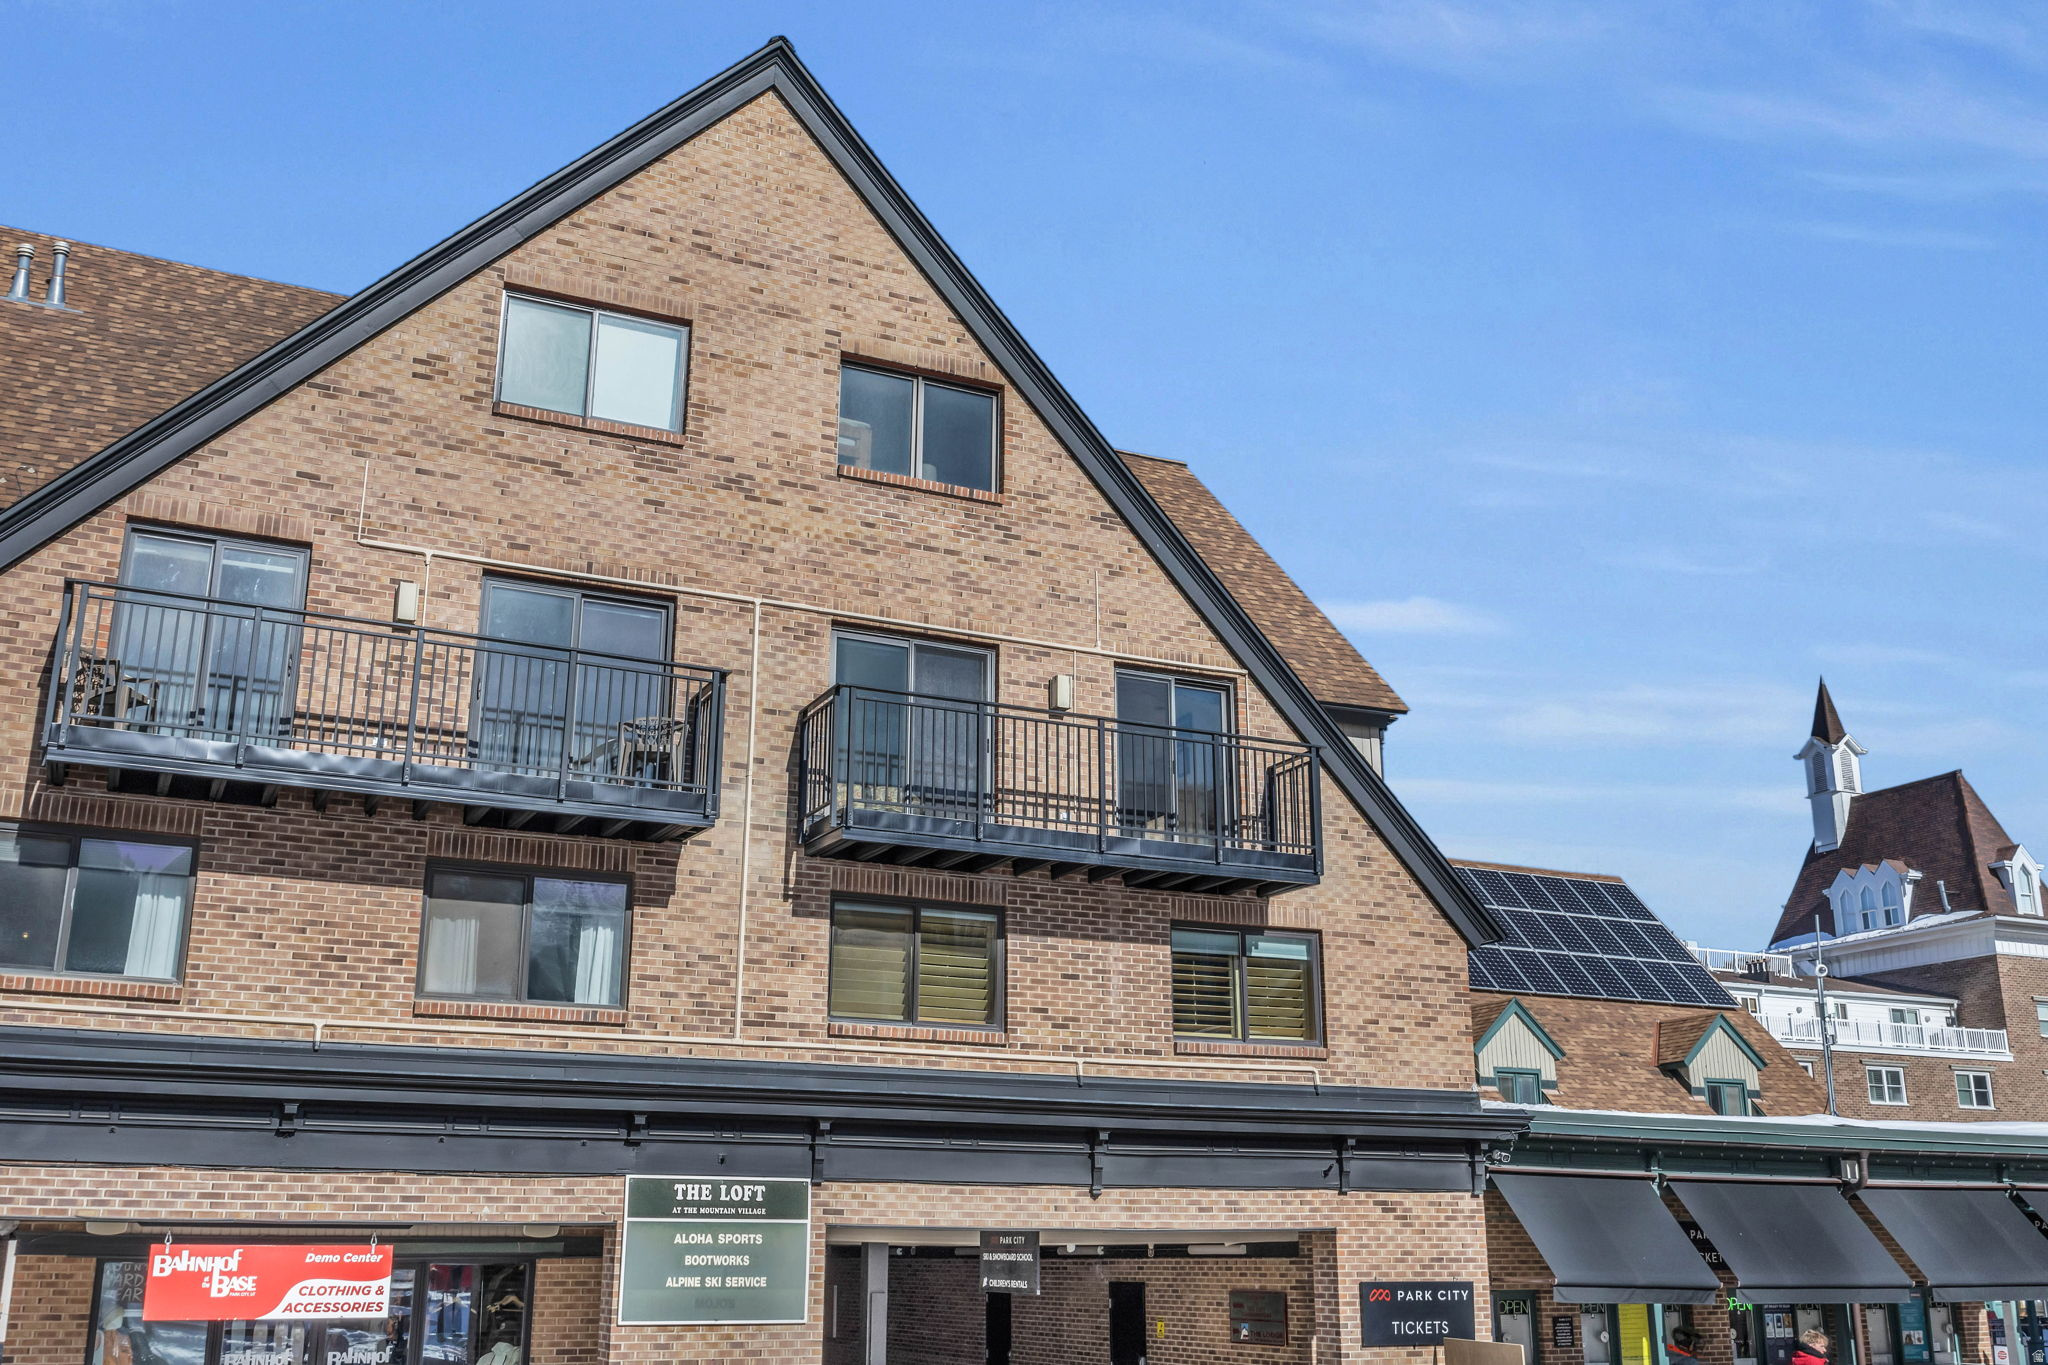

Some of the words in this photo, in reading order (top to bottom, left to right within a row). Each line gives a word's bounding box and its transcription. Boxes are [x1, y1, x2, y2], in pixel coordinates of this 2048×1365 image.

[674, 1183, 712, 1200] THE
[719, 1184, 766, 1201] LOFT
[673, 1233, 713, 1244] ALOHA
[718, 1234, 763, 1244] SPORTS
[1000, 1236, 1012, 1244] PARK
[1013, 1236, 1025, 1244] CITY
[305, 1253, 340, 1263] Demo
[343, 1253, 383, 1263] Center
[684, 1255, 750, 1266] BOOTWORKS
[210, 1275, 257, 1297] BASE
[665, 1277, 701, 1287] ALPINE
[705, 1277, 721, 1287] SKI
[725, 1277, 767, 1287] SERVICE
[298, 1285, 372, 1296] CLOTHING
[375, 1285, 385, 1295] &
[1397, 1290, 1432, 1300] PARK
[1437, 1290, 1468, 1300] CITY
[282, 1302, 385, 1313] ACCESSORIES
[1499, 1300, 1529, 1313] OPEN
[1392, 1321, 1449, 1334] TICKETS
